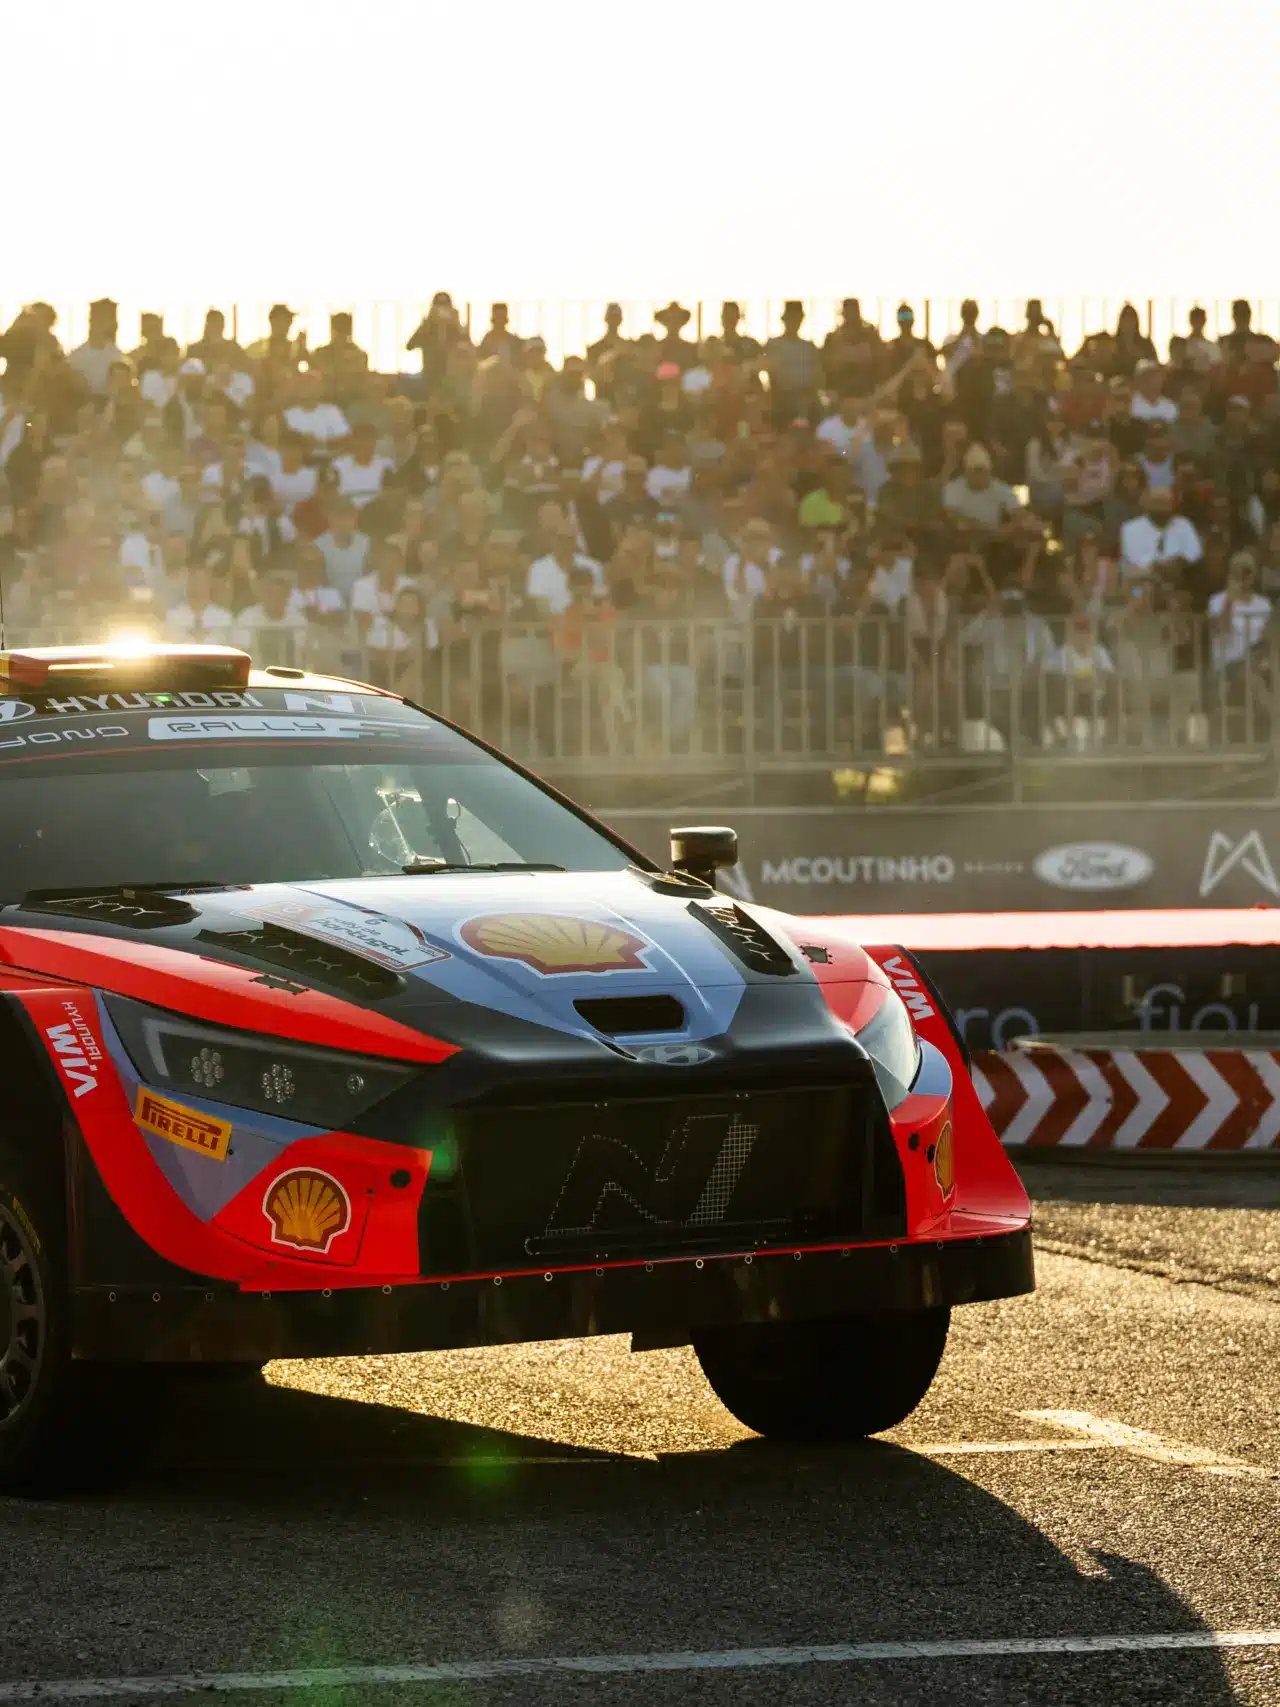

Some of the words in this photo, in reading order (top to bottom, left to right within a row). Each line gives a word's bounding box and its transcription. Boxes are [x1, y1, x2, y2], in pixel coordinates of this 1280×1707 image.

[45, 692, 263, 713] HYUNDAI
[167, 720, 325, 733] RALLY
[762, 855, 955, 884] MCOUTINHO
[882, 956, 936, 1020] WIA
[62, 1001, 103, 1060] HYUNDAI
[46, 1023, 98, 1099] WIA
[140, 1096, 223, 1151] PIRELLI
